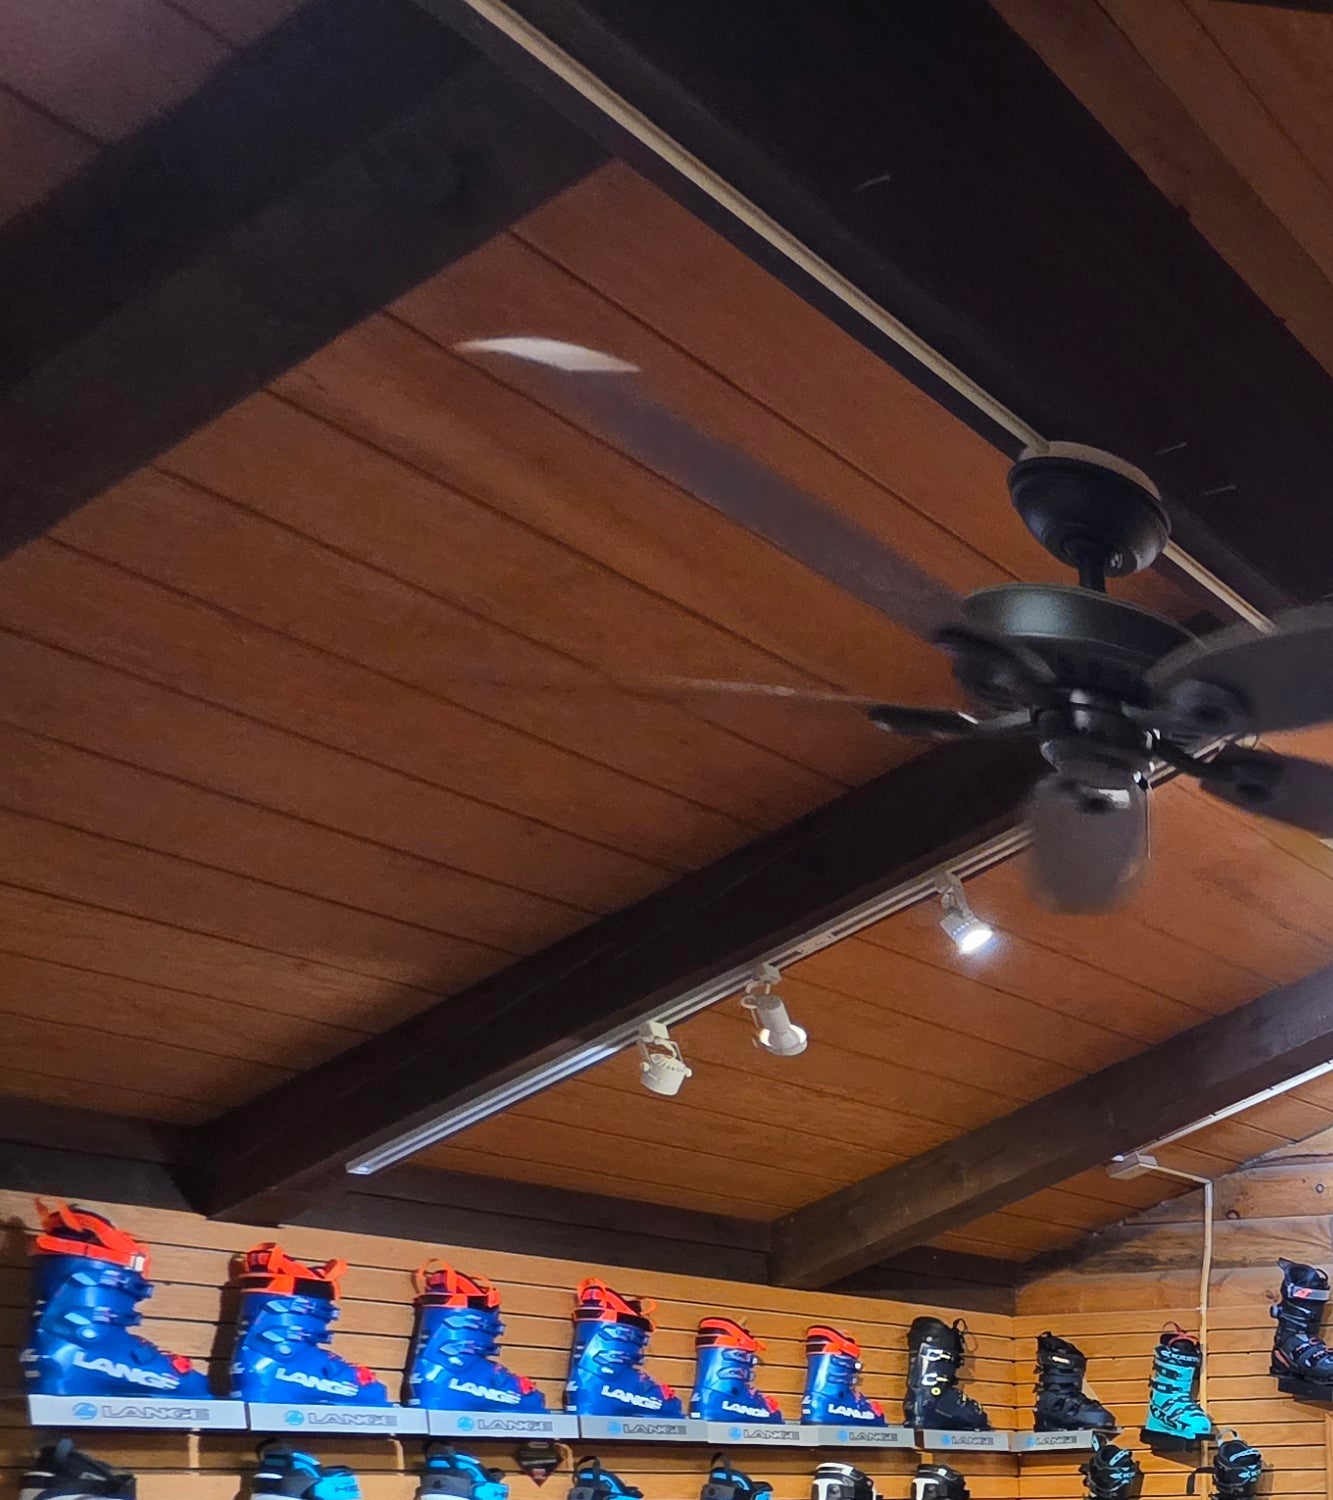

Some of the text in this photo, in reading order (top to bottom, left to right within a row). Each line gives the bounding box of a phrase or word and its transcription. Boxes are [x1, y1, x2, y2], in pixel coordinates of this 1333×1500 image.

[73, 1351, 180, 1390] LANGE
[275, 1367, 359, 1396] LANGE
[448, 1378, 521, 1405] LANGE
[602, 1385, 663, 1411] LANGE
[102, 1405, 210, 1421] LANGE
[308, 1412, 397, 1426] LANGE
[478, 1419, 553, 1432] LANGE
[623, 1424, 686, 1435] LANGE
[743, 1429, 800, 1441] LANGE
[849, 1432, 898, 1442] LANGE
